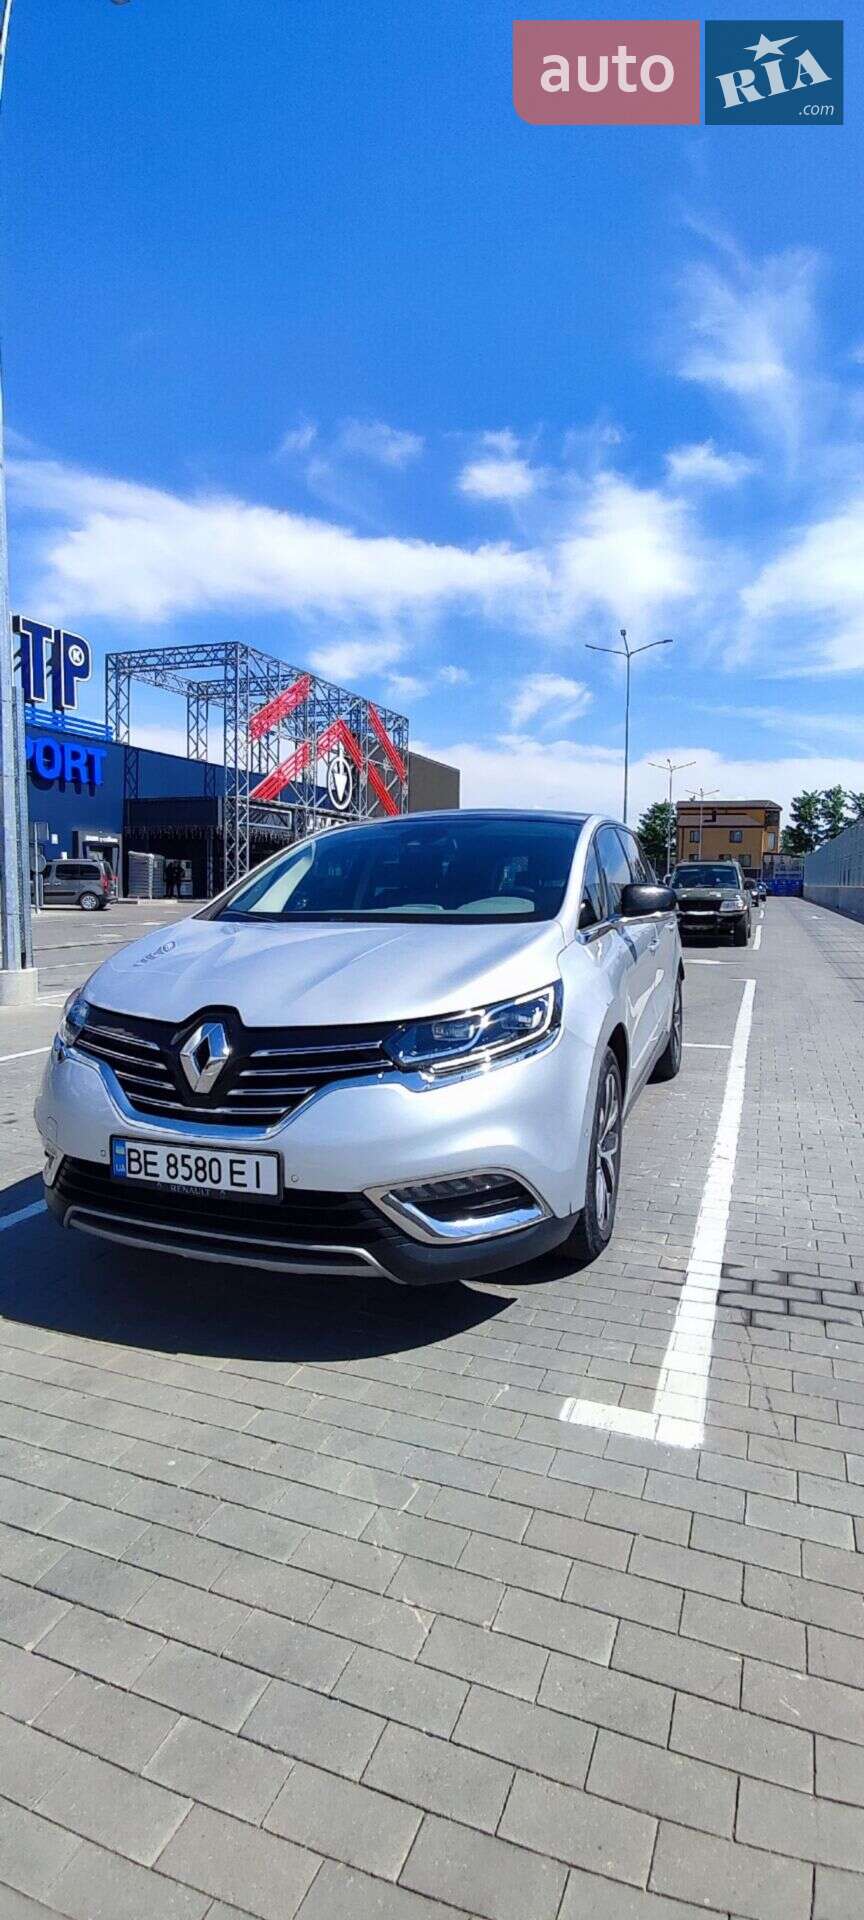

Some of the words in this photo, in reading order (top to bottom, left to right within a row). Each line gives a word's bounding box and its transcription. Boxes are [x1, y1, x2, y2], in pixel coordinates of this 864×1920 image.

[127, 1148, 160, 1178] BE
[166, 1152, 222, 1185] 8580
[230, 1159, 260, 1188] EI
[170, 1184, 210, 1197] RENAULT
